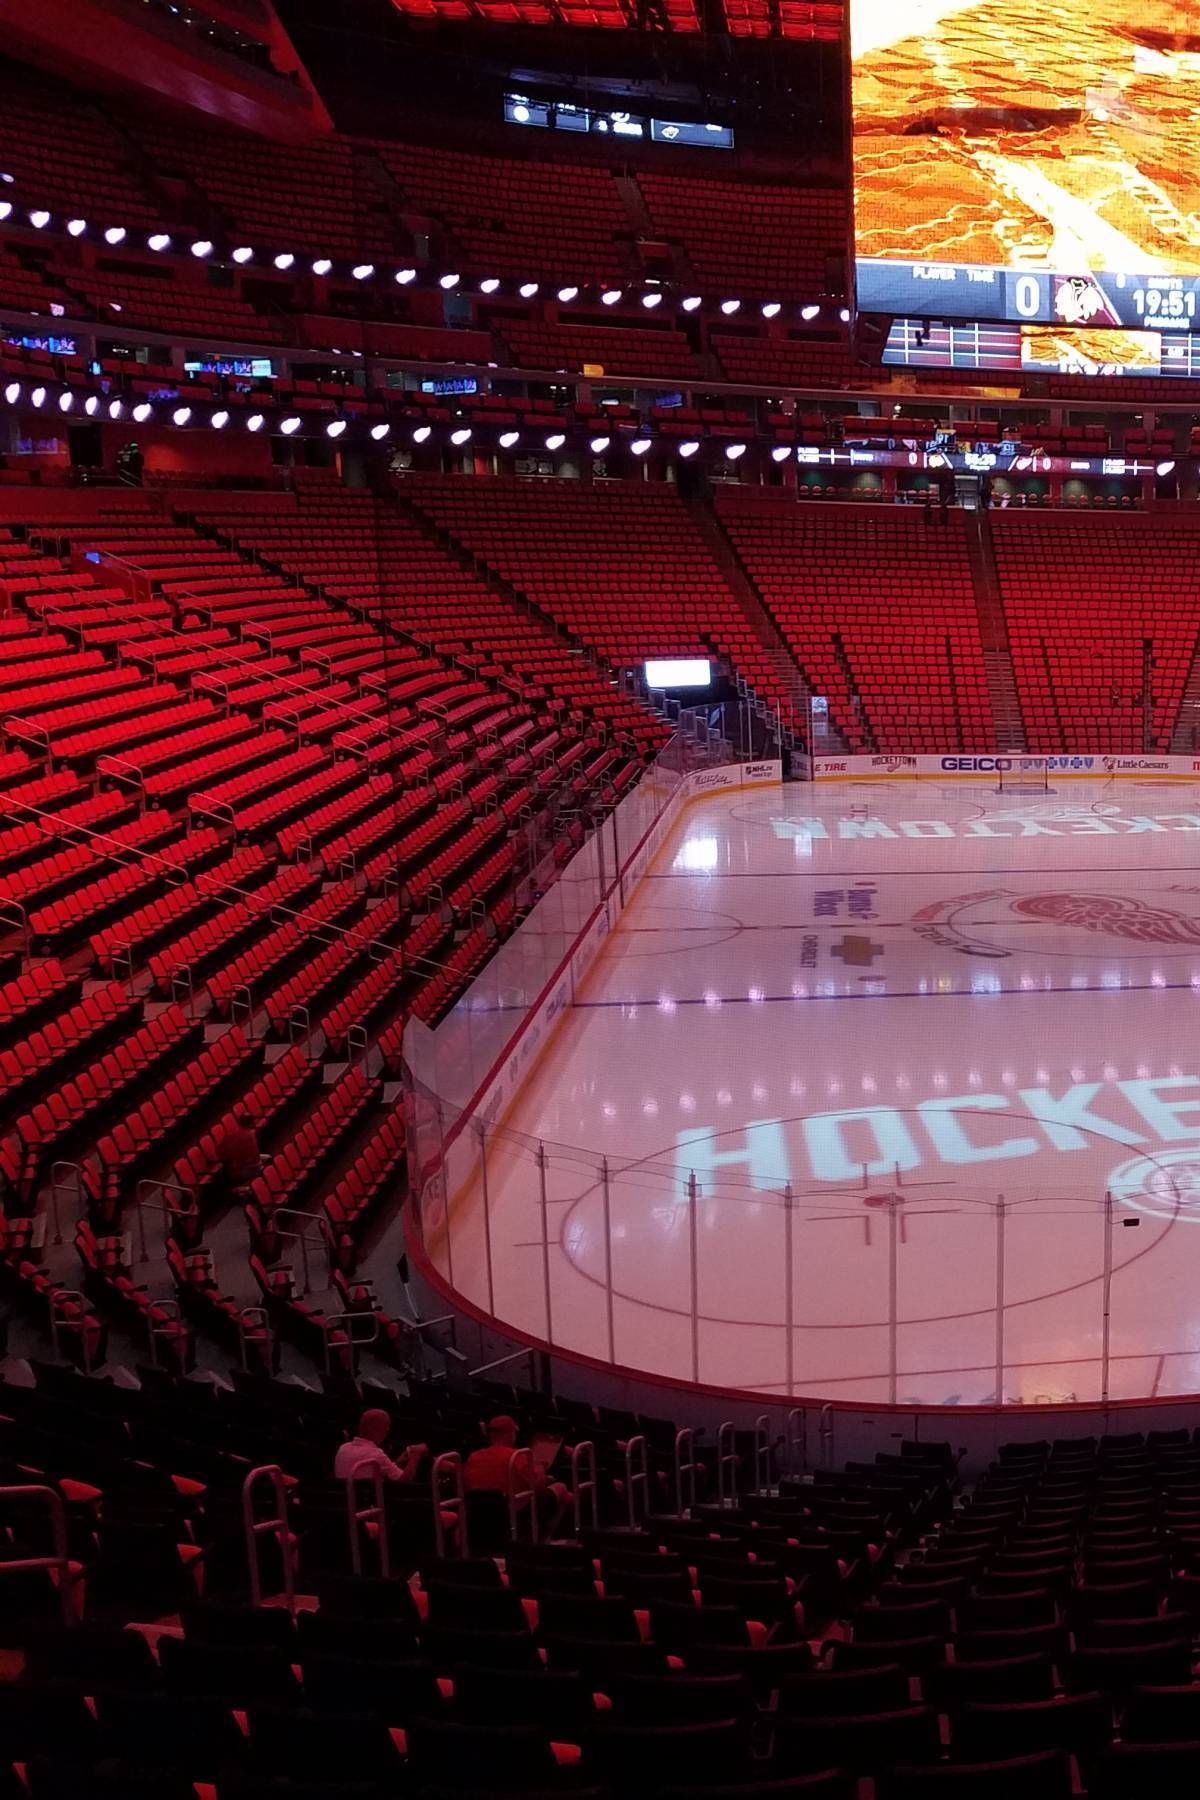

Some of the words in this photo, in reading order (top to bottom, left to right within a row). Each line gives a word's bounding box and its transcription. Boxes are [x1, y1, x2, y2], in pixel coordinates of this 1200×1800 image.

[1015, 276, 1041, 317] 0
[1133, 289, 1196, 317] 19:51
[824, 763, 847, 772] TIRE
[941, 757, 1012, 771] GEICO
[1117, 759, 1138, 769] Little
[1138, 759, 1169, 770] Caesars
